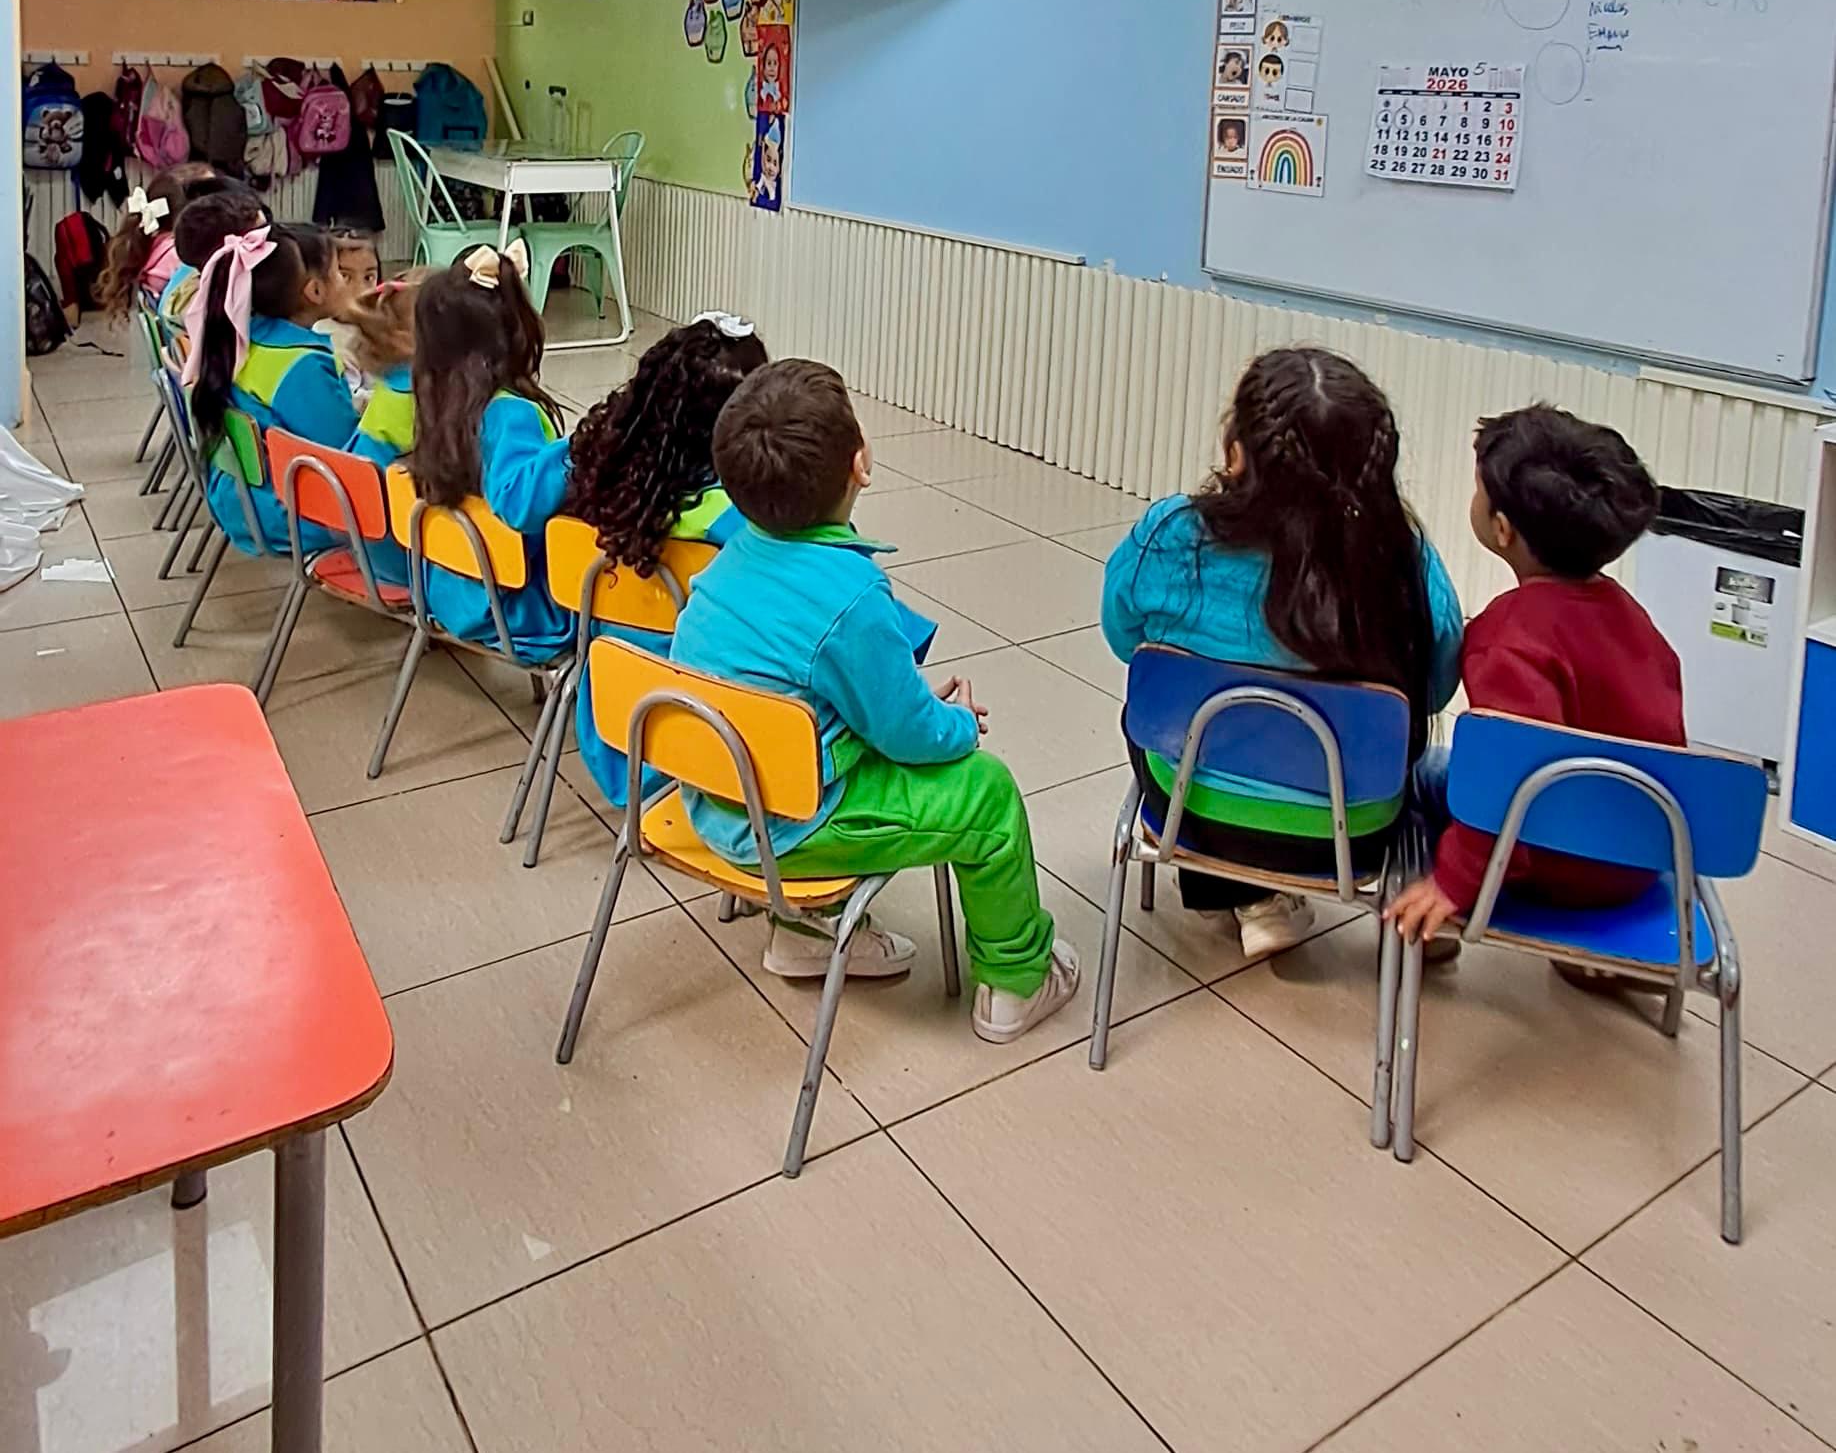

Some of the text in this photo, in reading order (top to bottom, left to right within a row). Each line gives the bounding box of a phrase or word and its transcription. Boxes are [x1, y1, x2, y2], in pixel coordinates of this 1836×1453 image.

[1428, 67, 1468, 77] MAYO
[1473, 62, 1488, 76] 5
[1426, 79, 1468, 90] 2026
[1463, 102, 1513, 113] 1 2 3
[1381, 114, 1514, 131] 4 5 6 7 8 9 10
[1377, 129, 1513, 147] 11 12 13 14 15 16 17
[1373, 145, 1511, 164] 18 19 20 21 22 23 24
[1370, 160, 1508, 181] 25 26 27 28 29 30 31
